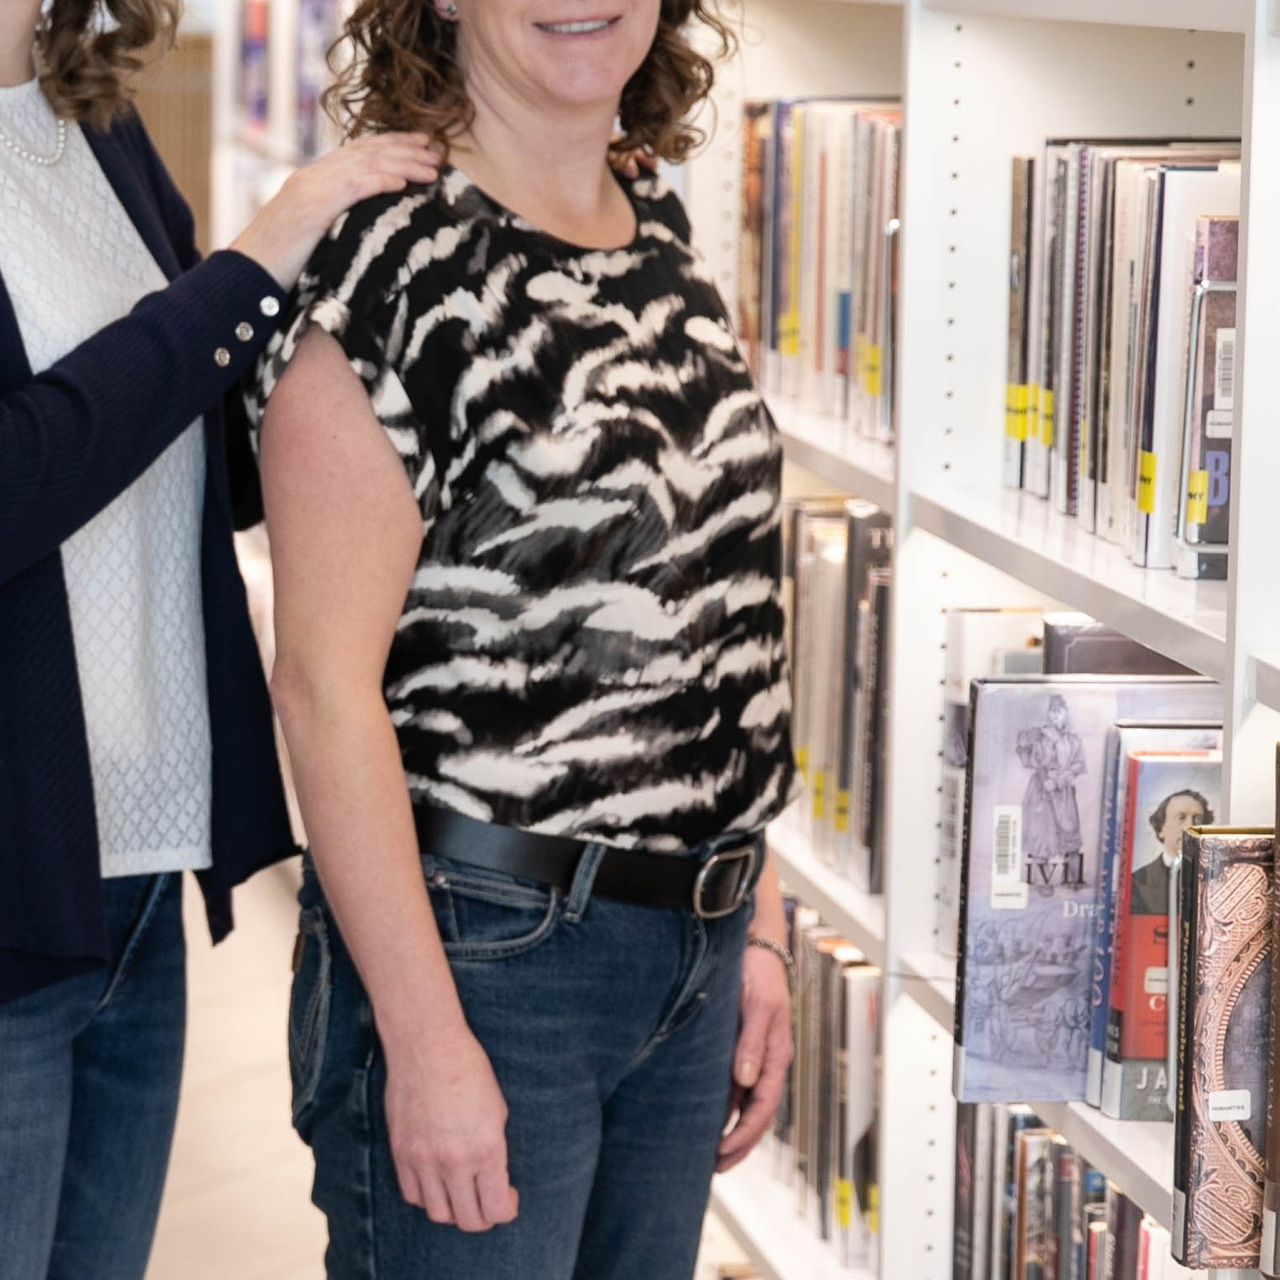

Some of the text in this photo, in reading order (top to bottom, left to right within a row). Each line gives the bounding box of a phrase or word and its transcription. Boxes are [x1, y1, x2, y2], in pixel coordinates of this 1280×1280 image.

[1025, 852, 1087, 886] ivil
[1177, 920, 1191, 1112] Photography and
